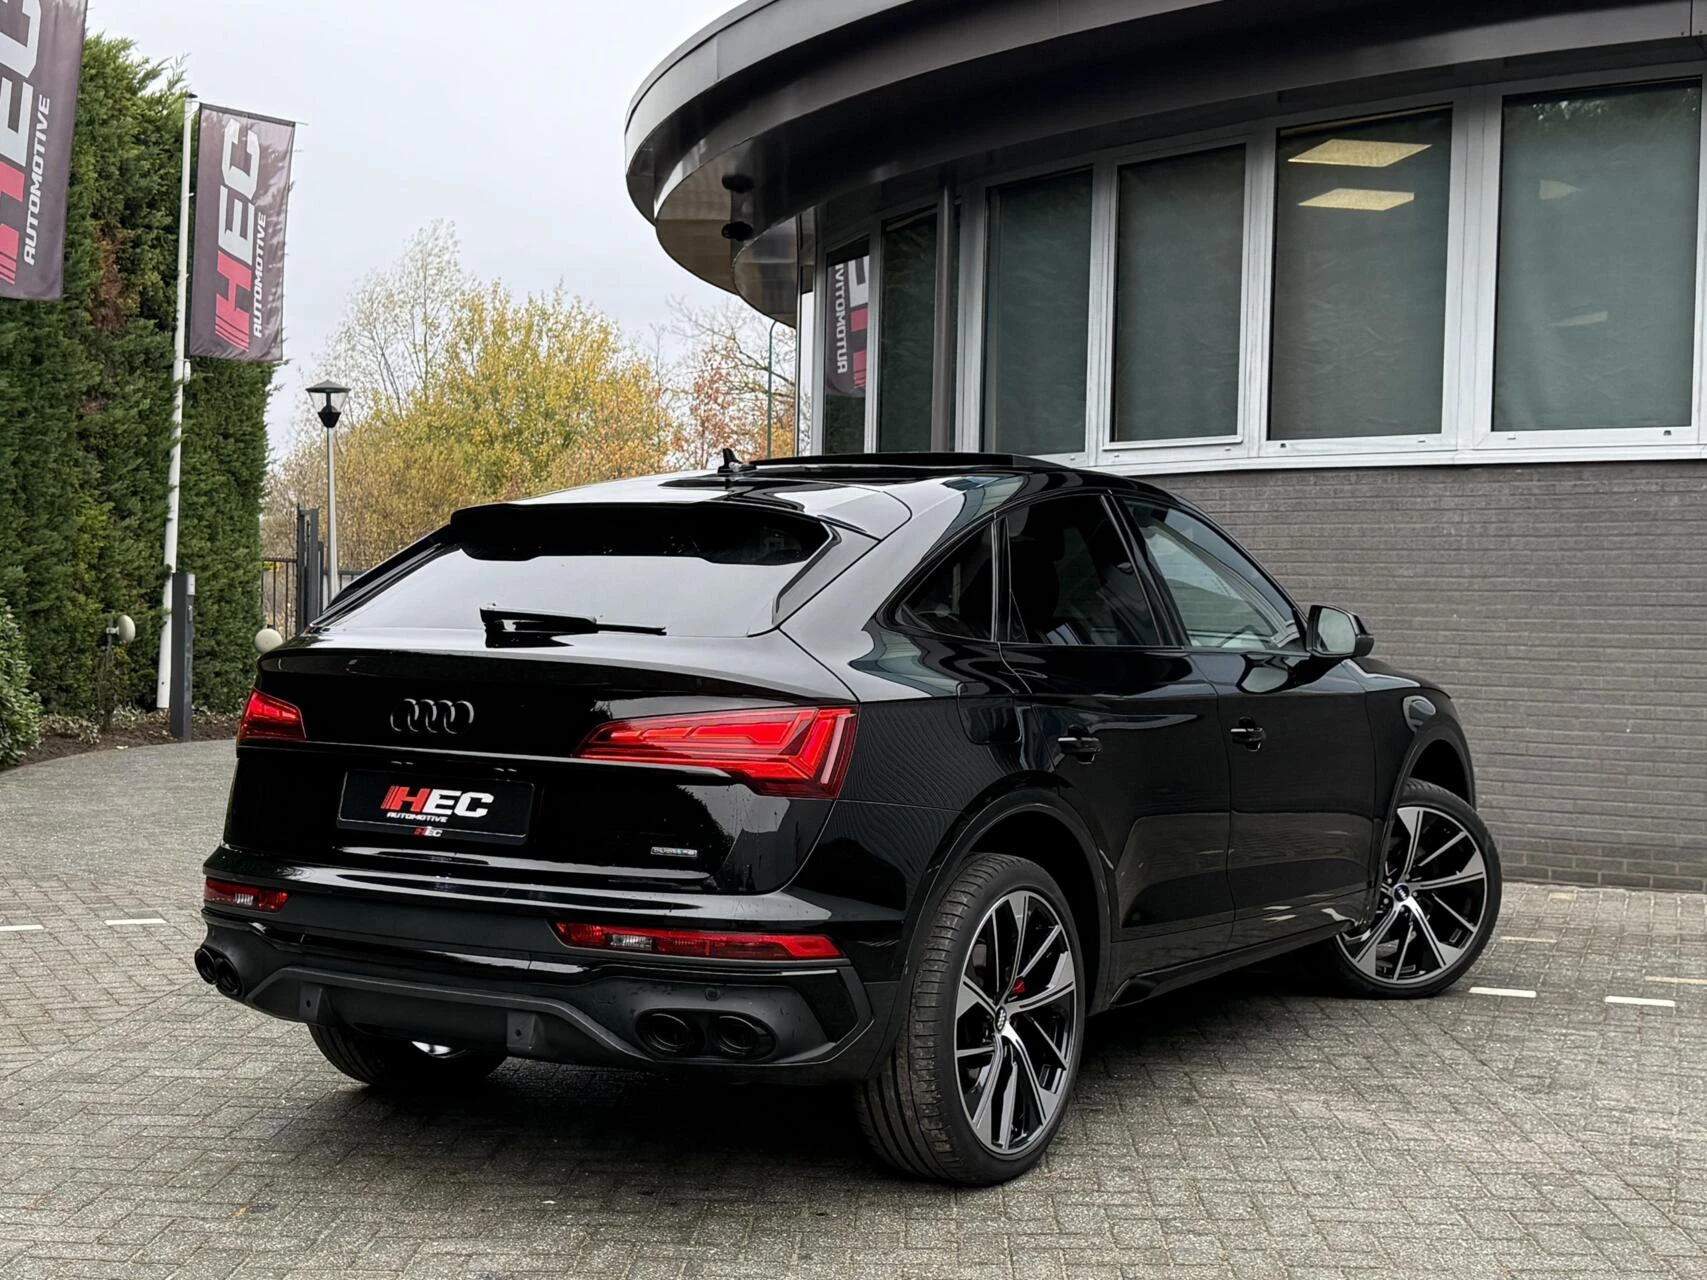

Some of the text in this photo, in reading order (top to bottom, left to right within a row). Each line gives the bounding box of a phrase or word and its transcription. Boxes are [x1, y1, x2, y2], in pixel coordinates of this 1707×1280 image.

[24, 94, 50, 265] AUTOMOTIVE
[215, 119, 260, 352] HEC
[253, 213, 267, 338] AUTOMOTIVE
[380, 785, 495, 817] HEC
[386, 811, 449, 823] AUTOMOTIVE
